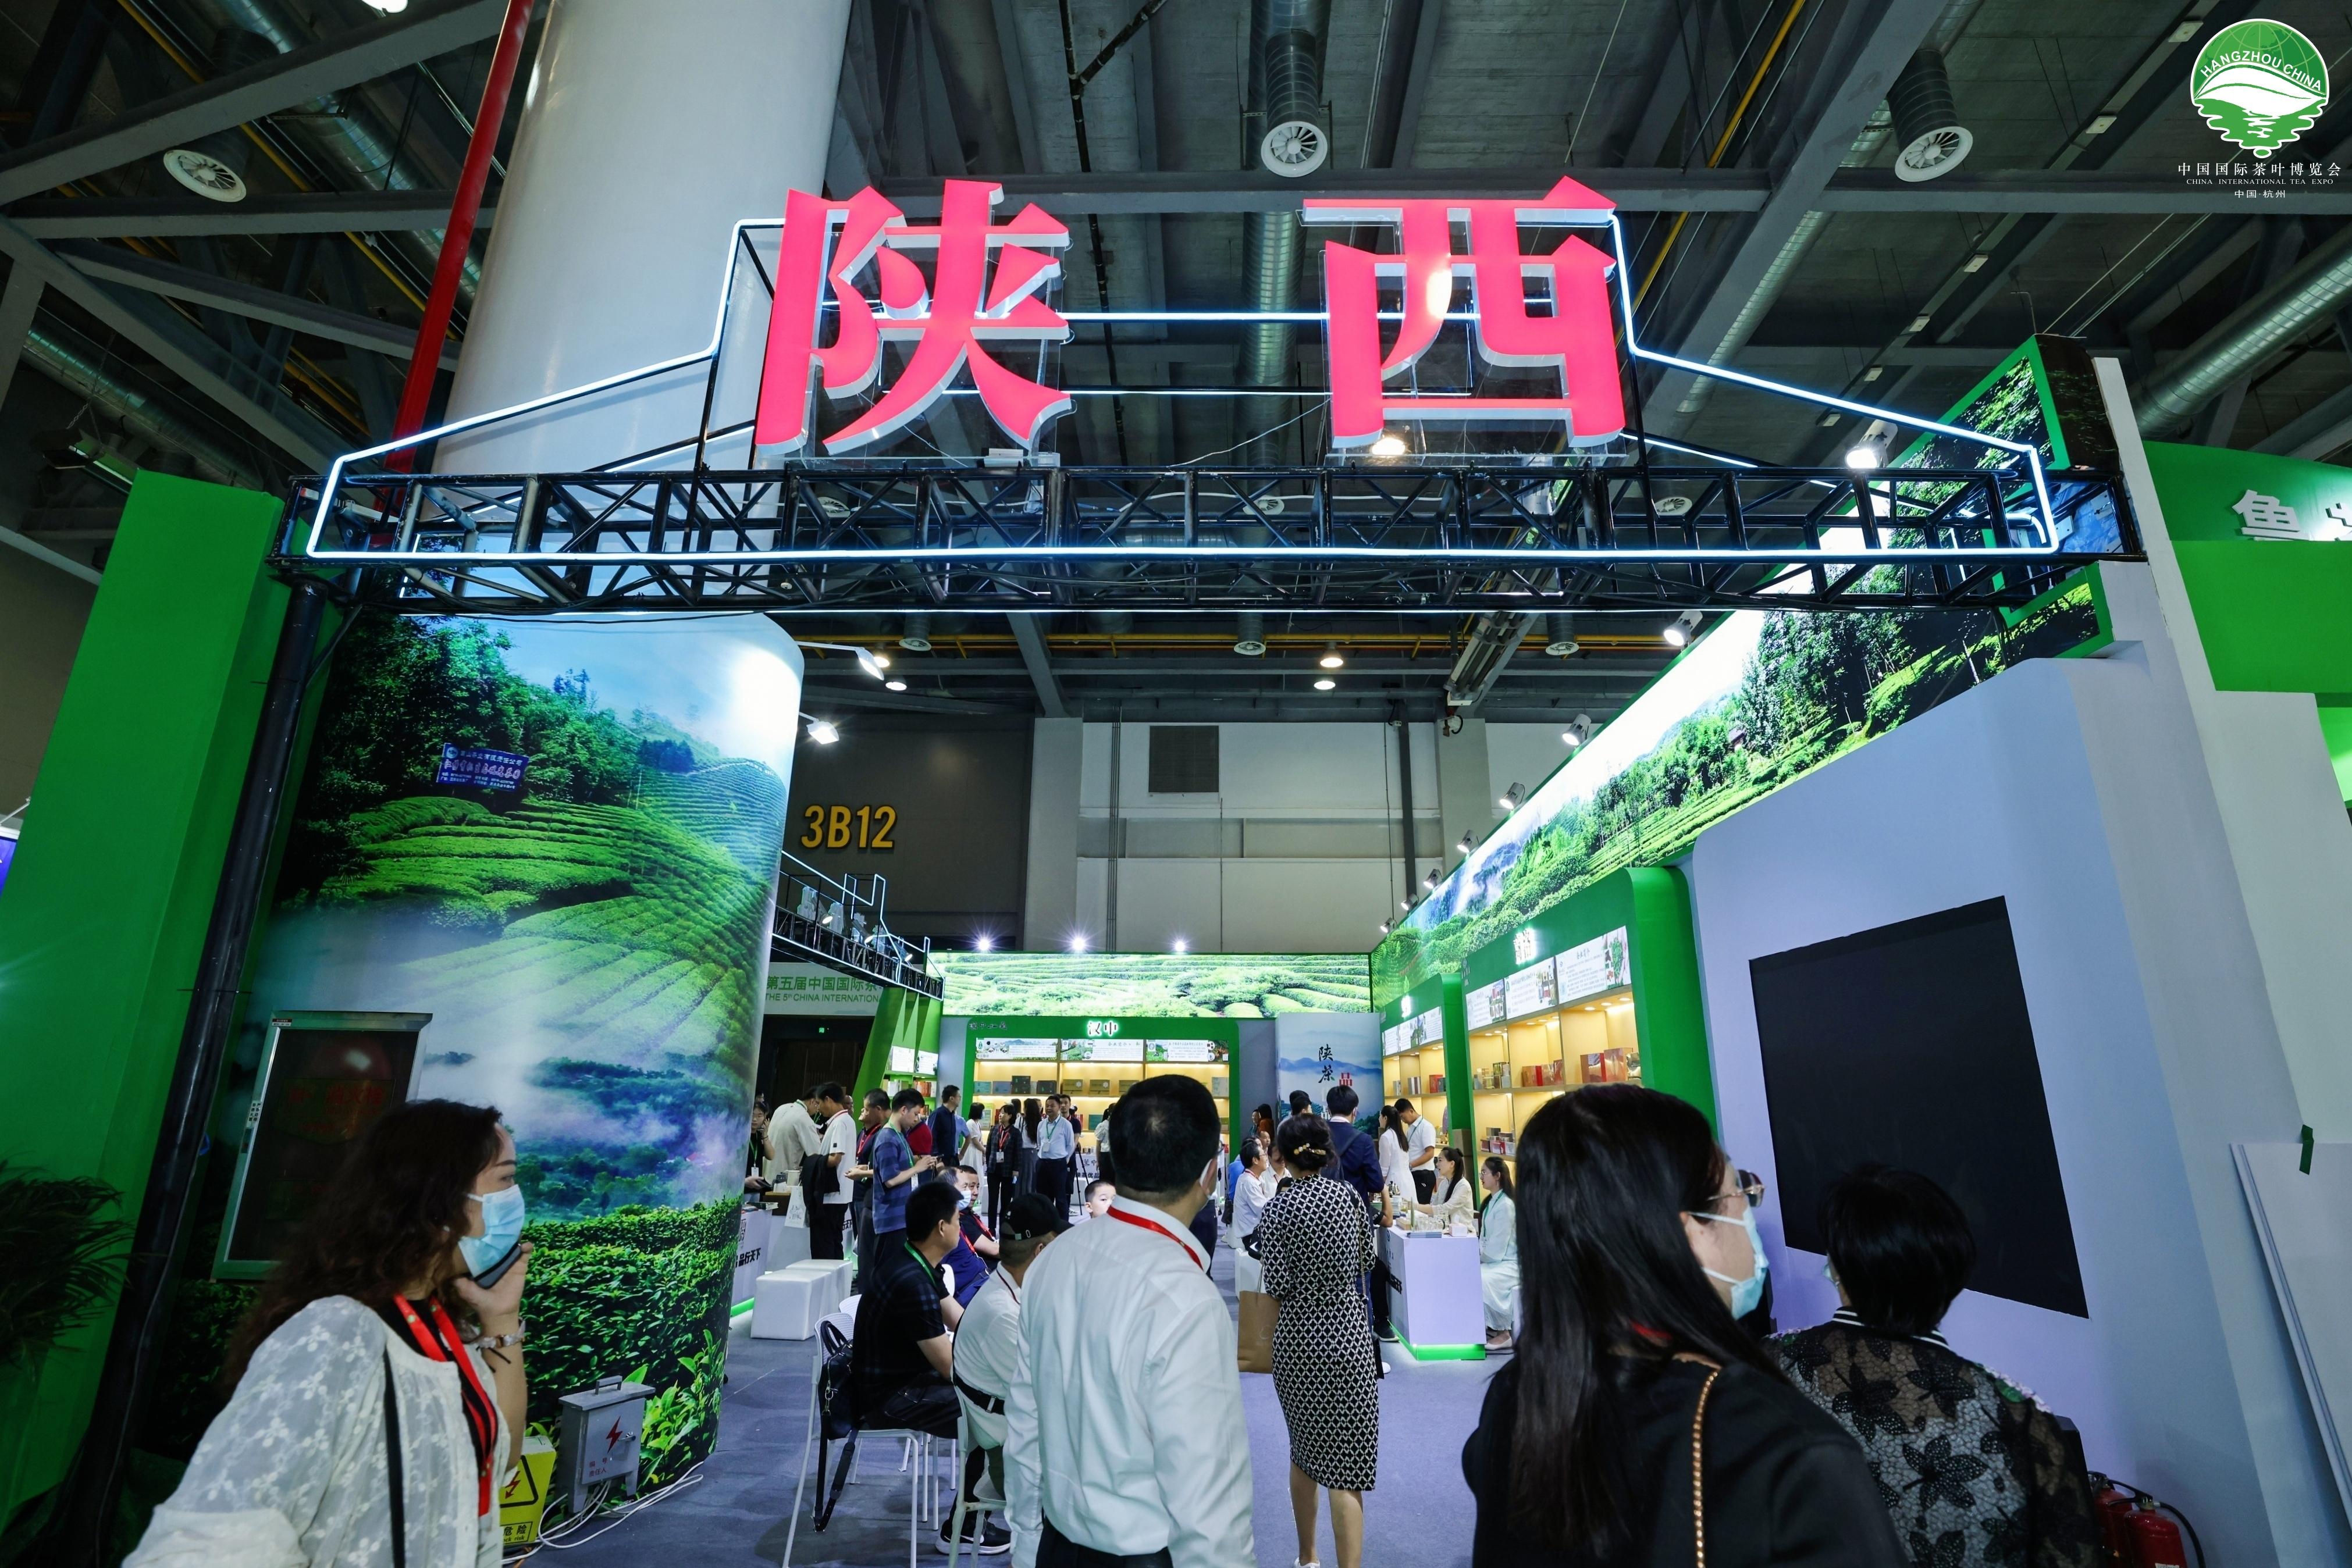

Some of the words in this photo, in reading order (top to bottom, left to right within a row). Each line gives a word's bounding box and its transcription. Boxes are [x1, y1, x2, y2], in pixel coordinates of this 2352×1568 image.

[755, 176, 1627, 456] 陕西
[801, 806, 896, 848] 3B12
[794, 993, 820, 1002] CHINA
[1088, 1021, 1117, 1036] 汉中
[1318, 1043, 1335, 1083] 陕茶
[735, 1248, 762, 1268] 品行天下
